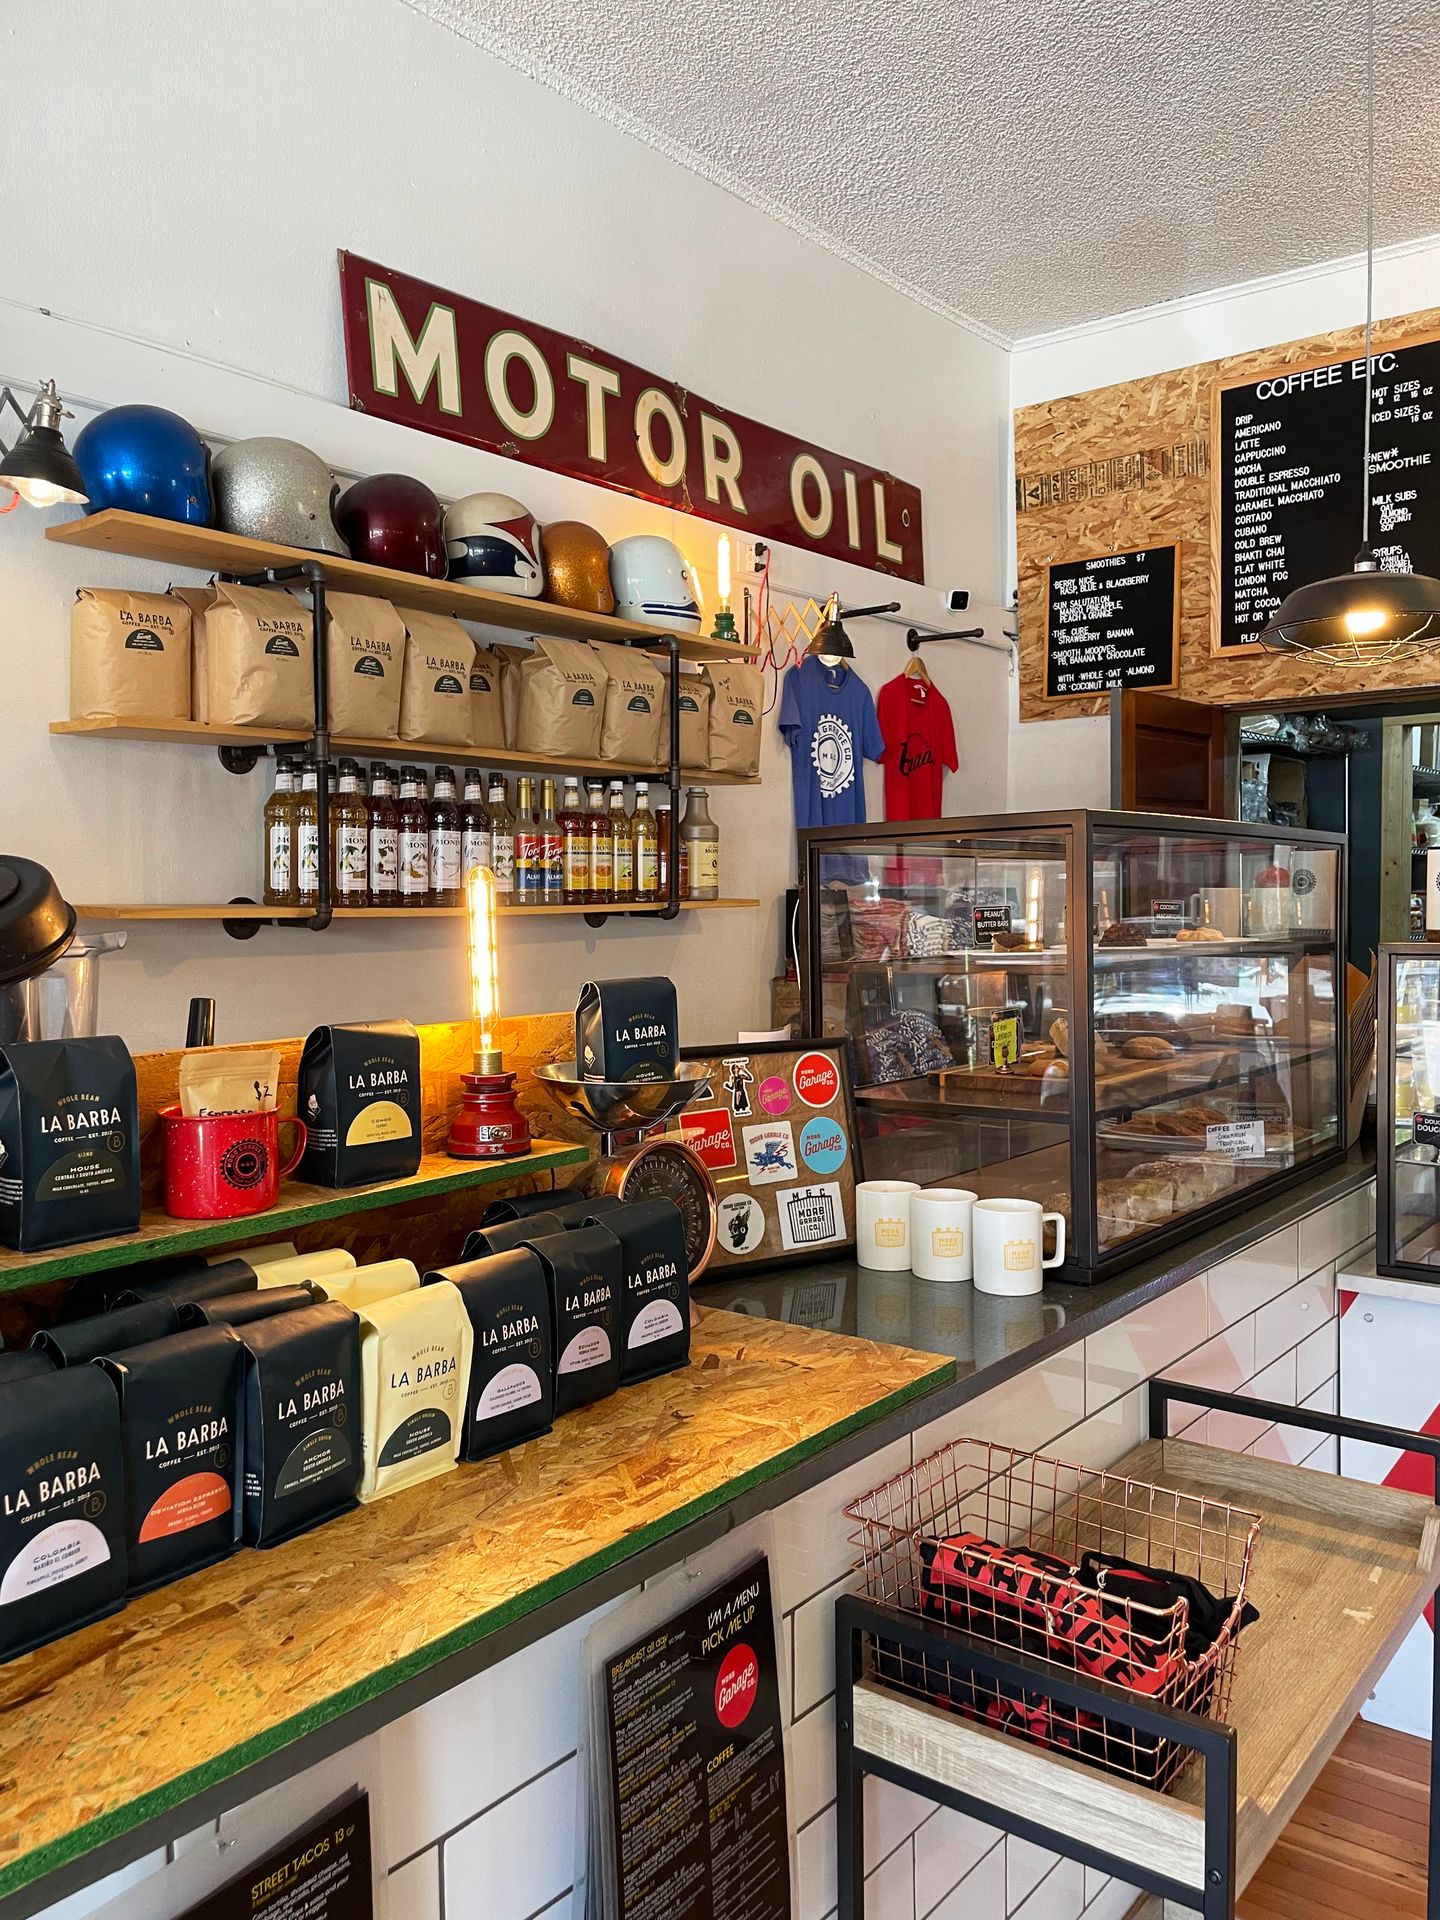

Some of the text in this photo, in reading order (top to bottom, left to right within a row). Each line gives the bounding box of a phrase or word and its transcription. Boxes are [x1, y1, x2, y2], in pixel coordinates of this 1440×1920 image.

[1256, 353, 1399, 400] COFFEE ETC.
[1372, 380, 1420, 399] HOT SIZES
[1393, 394, 1400, 402] 12
[1411, 390, 1418, 398] 16
[1423, 386, 1433, 396] OZ
[365, 277, 902, 564] MOTOR OIL
[1235, 414, 1253, 426] DRIP
[1371, 405, 1420, 423] ICED SIZES
[1411, 411, 1433, 423] 16 OZ
[1235, 420, 1281, 439] AMERICANO
[1235, 438, 1260, 451] LATTE
[1235, 445, 1286, 463] CAPPUCCINO
[1235, 463, 1261, 476] MOCHA
[1368, 453, 1431, 474] SMOOTHIE
[1235, 466, 1310, 488] DOUBLE ESPRESSO
[1235, 473, 1341, 500] TRADITIONAL MACCHIATO
[1235, 489, 1324, 513] CARAMEL MACCHIATO
[1372, 490, 1417, 506] MILK SUBS
[1380, 503, 1394, 512] OAT
[1381, 507, 1408, 518] ALMOND
[1235, 511, 1272, 525] CORTADO
[1380, 513, 1412, 525] COCONUT
[1235, 525, 1267, 537] CUBANO
[1380, 523, 1394, 532] SOY
[1235, 535, 1282, 550] COLD BREW
[1235, 546, 1285, 562] BHAKTI CHAI
[1372, 545, 1402, 558] SYRUPS
[1086, 553, 1146, 570] SMOOTHIES $7
[1235, 559, 1285, 575] FLAT WHITE
[1079, 575, 1095, 585] NICE
[1080, 575, 1149, 593] BLUE BLACKBERRY
[1235, 571, 1288, 587] LONDON FOG
[1235, 587, 1268, 599] MATCHA
[1235, 597, 1281, 611] HOT COCOA
[120, 610, 173, 627] LA BARBA
[257, 618, 304, 633] LA BARBA
[1235, 612, 1263, 624] HOT OR
[350, 635, 391, 653] LA BARBA
[1058, 628, 1134, 645] STRAWBERRY BANANA
[426, 656, 437, 667] LA
[440, 659, 466, 671] BARBA
[1069, 648, 1146, 664] BANANA CHOCOLATE
[1057, 679, 1123, 692] OR MILK
[1058, 673, 1074, 683] WITH
[983, 909, 1005, 918] PEANUT
[977, 920, 996, 929] BUTTER
[616, 1024, 667, 1042] LA BARBA
[349, 1069, 408, 1090] LA BARBA
[800, 1070, 834, 1090] Garage
[254, 1080, 273, 1101] $2
[41, 1107, 122, 1133] LA BARBA
[1207, 1125, 1230, 1133] COFFEE
[54, 1136, 74, 1144] COFFEE
[686, 1129, 733, 1151] Garage CO.
[804, 1134, 842, 1157] Garage
[55, 1168, 113, 1181] CENTRAL SOUTH AMERICA
[70, 1163, 100, 1173] HOUSE
[792, 1189, 812, 1201] M G
[798, 1206, 825, 1219] MOAB
[799, 1214, 826, 1226] GARAGE
[628, 1262, 677, 1289] LA BARBA
[565, 1285, 612, 1312] LA BARBA
[483, 1315, 539, 1347] LA BARBA
[431, 1344, 445, 1353] BEAN
[491, 1346, 507, 1355] COFFEE
[391, 1356, 457, 1389] LA BARBA
[278, 1379, 345, 1421] LA BARBA
[195, 1404, 213, 1414] BEAN
[289, 1417, 308, 1429] COFFEE
[146, 1416, 228, 1460] LA BARBA
[408, 1426, 431, 1439] HOUSE
[26, 1450, 79, 1477] WHOLE BEAN
[158, 1449, 208, 1470] COFFEE EST.
[303, 1449, 332, 1465] ANCHOR
[4, 1461, 102, 1516] LA BARBA
[20, 1499, 77, 1525] COFFEE EST.
[33, 1540, 82, 1564] COLOMBIA
[707, 1581, 761, 1630] I'M A MENU
[701, 1604, 755, 1656] PICK ME UP
[611, 1646, 646, 1678] BREAKFAST
[655, 1633, 669, 1648] day
[718, 1662, 755, 1712] Garage
[706, 1743, 735, 1774] COFFEE
[251, 1863, 290, 1900] STREET
[292, 1837, 330, 1873] TACOS
[335, 1827, 345, 1846] 13
